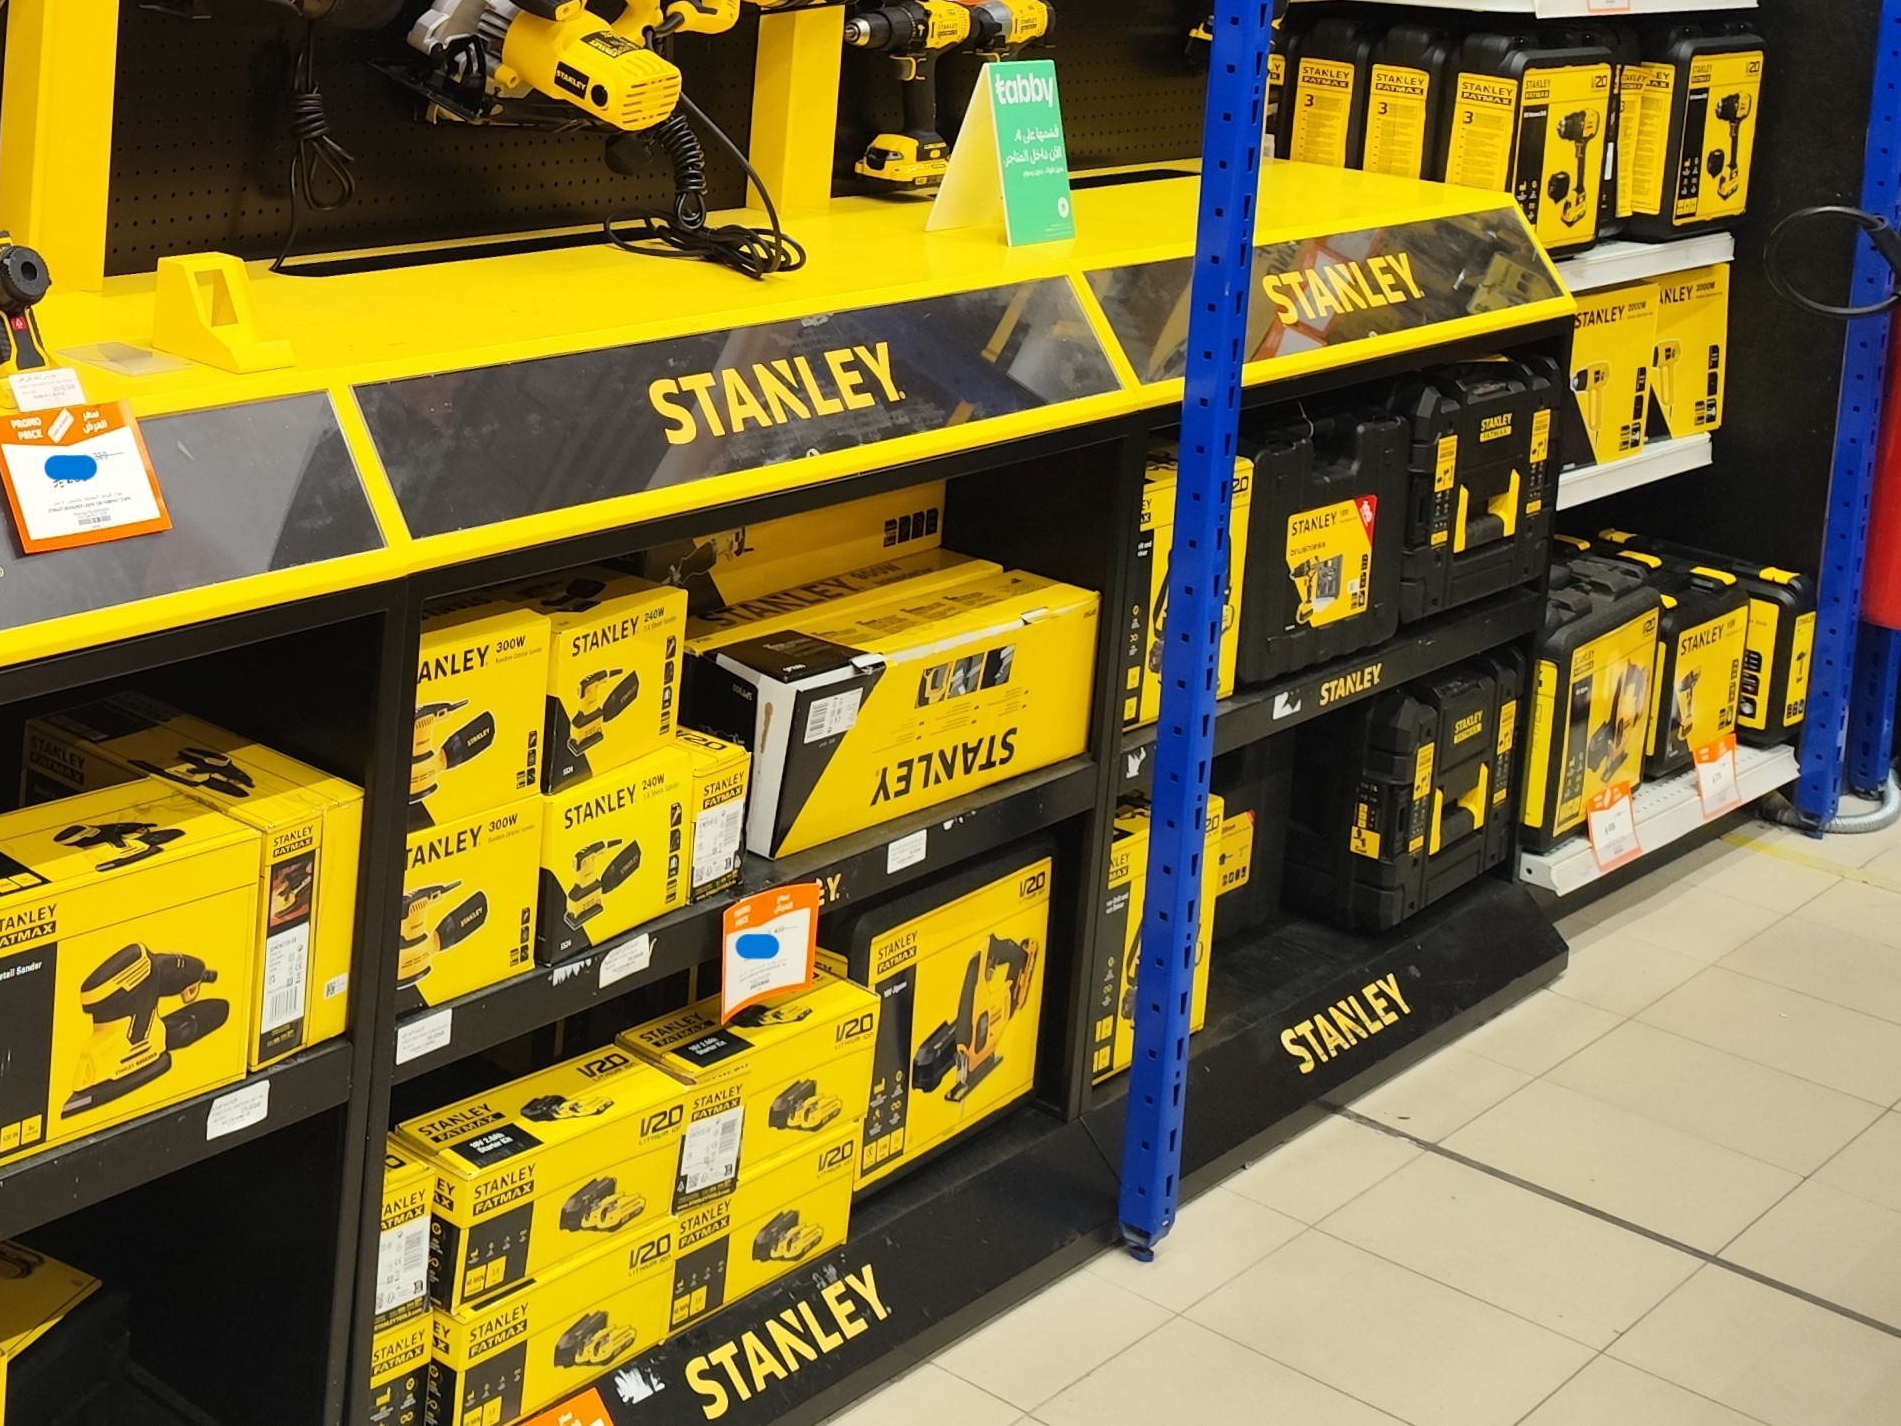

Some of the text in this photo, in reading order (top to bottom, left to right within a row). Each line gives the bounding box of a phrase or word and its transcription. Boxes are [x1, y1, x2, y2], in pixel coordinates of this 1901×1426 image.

[555, 68, 587, 92] STANLEY
[1302, 66, 1350, 79] STANLEY
[1376, 73, 1424, 86] STANLEY
[996, 73, 1053, 108] tabby
[1304, 94, 1314, 107] 3
[1462, 82, 1513, 97] STANLEY
[1378, 102, 1388, 114] 3
[1463, 111, 1474, 124] 3
[1263, 252, 1422, 326] STANLEY
[1575, 305, 1626, 328] STANLEY
[649, 341, 900, 445] STANLEY
[10, 417, 42, 428] PROMO
[1481, 413, 1513, 431] STANLEY
[18, 430, 43, 440] PRICE
[1291, 511, 1338, 536] STANLEY
[571, 606, 666, 657] STANLEY 240W
[417, 635, 526, 685] ANLEY 300W
[1319, 663, 1381, 705] STANLEY
[1455, 710, 1483, 733] STANLEY
[870, 727, 1018, 807] STANLEY
[703, 771, 745, 797] STANLEY
[564, 773, 666, 830] STANLEY 240W
[703, 786, 743, 810] FATMAX
[273, 824, 313, 847] STANLEY
[488, 814, 518, 833] 300W
[274, 837, 311, 857] FATMAX
[878, 931, 918, 959] STANLEY
[16, 960, 43, 976] Sander
[1281, 973, 1411, 1074] STANLEY
[693, 1084, 743, 1110] STANLEY
[679, 1199, 731, 1234] STANLEY
[685, 1263, 888, 1420] STANLEY
